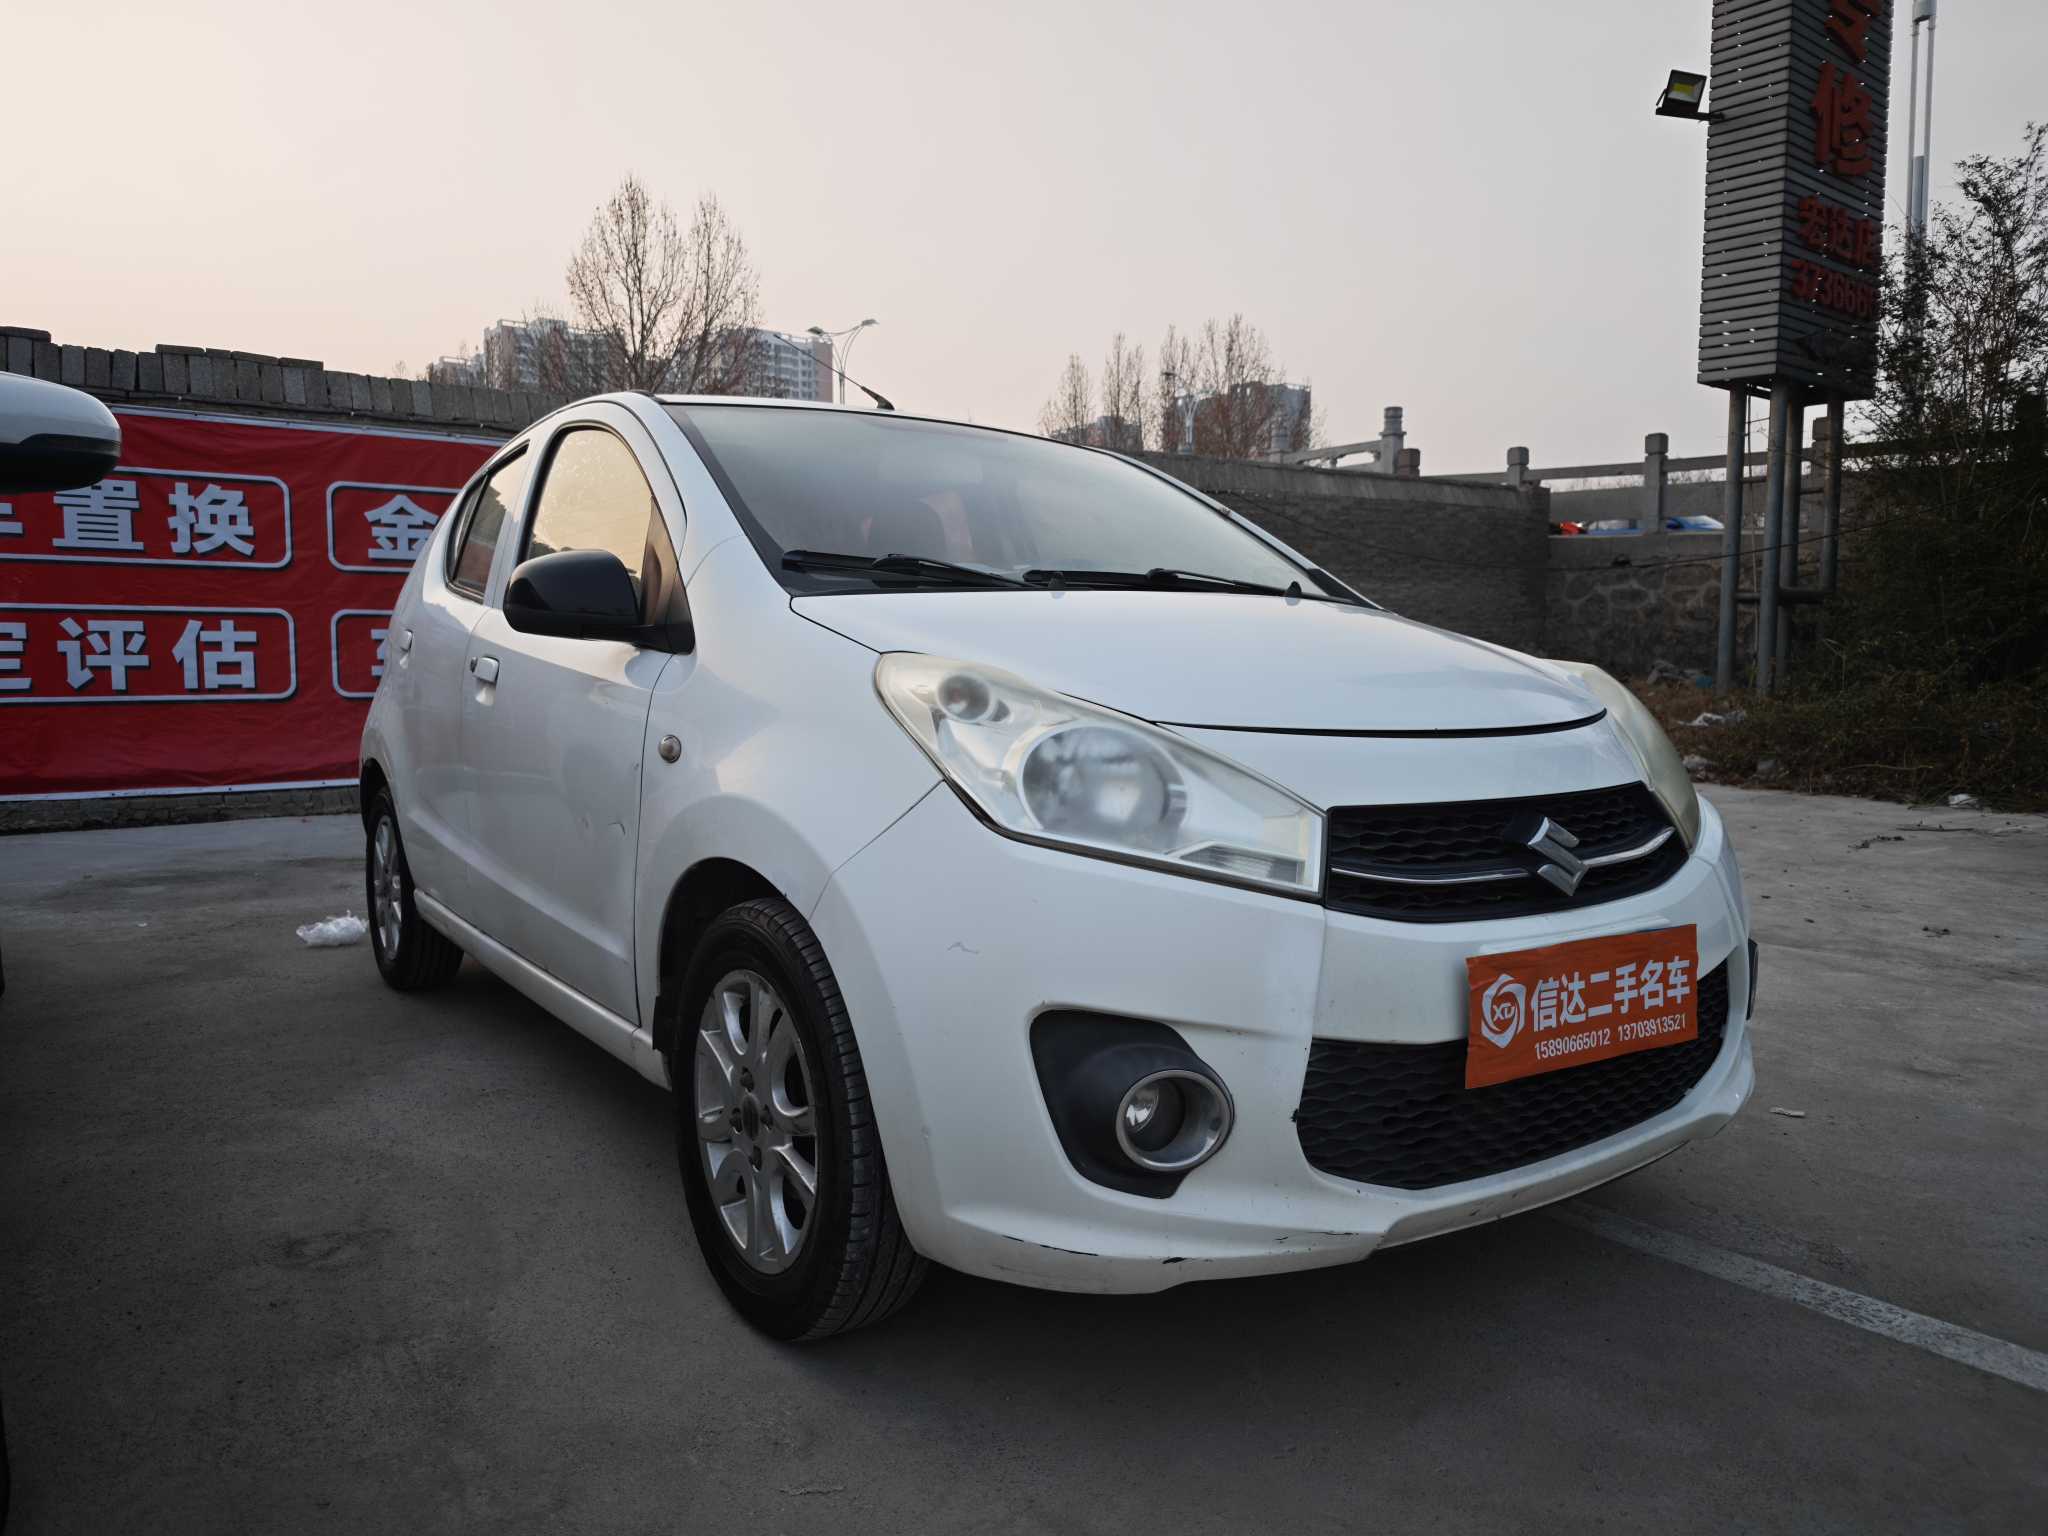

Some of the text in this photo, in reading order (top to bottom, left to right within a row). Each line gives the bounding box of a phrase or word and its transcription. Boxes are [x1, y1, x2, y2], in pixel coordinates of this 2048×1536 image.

[1531, 955, 1690, 1032] 信达二手名车
[1534, 1013, 1687, 1060] 15890665012 13703913521
